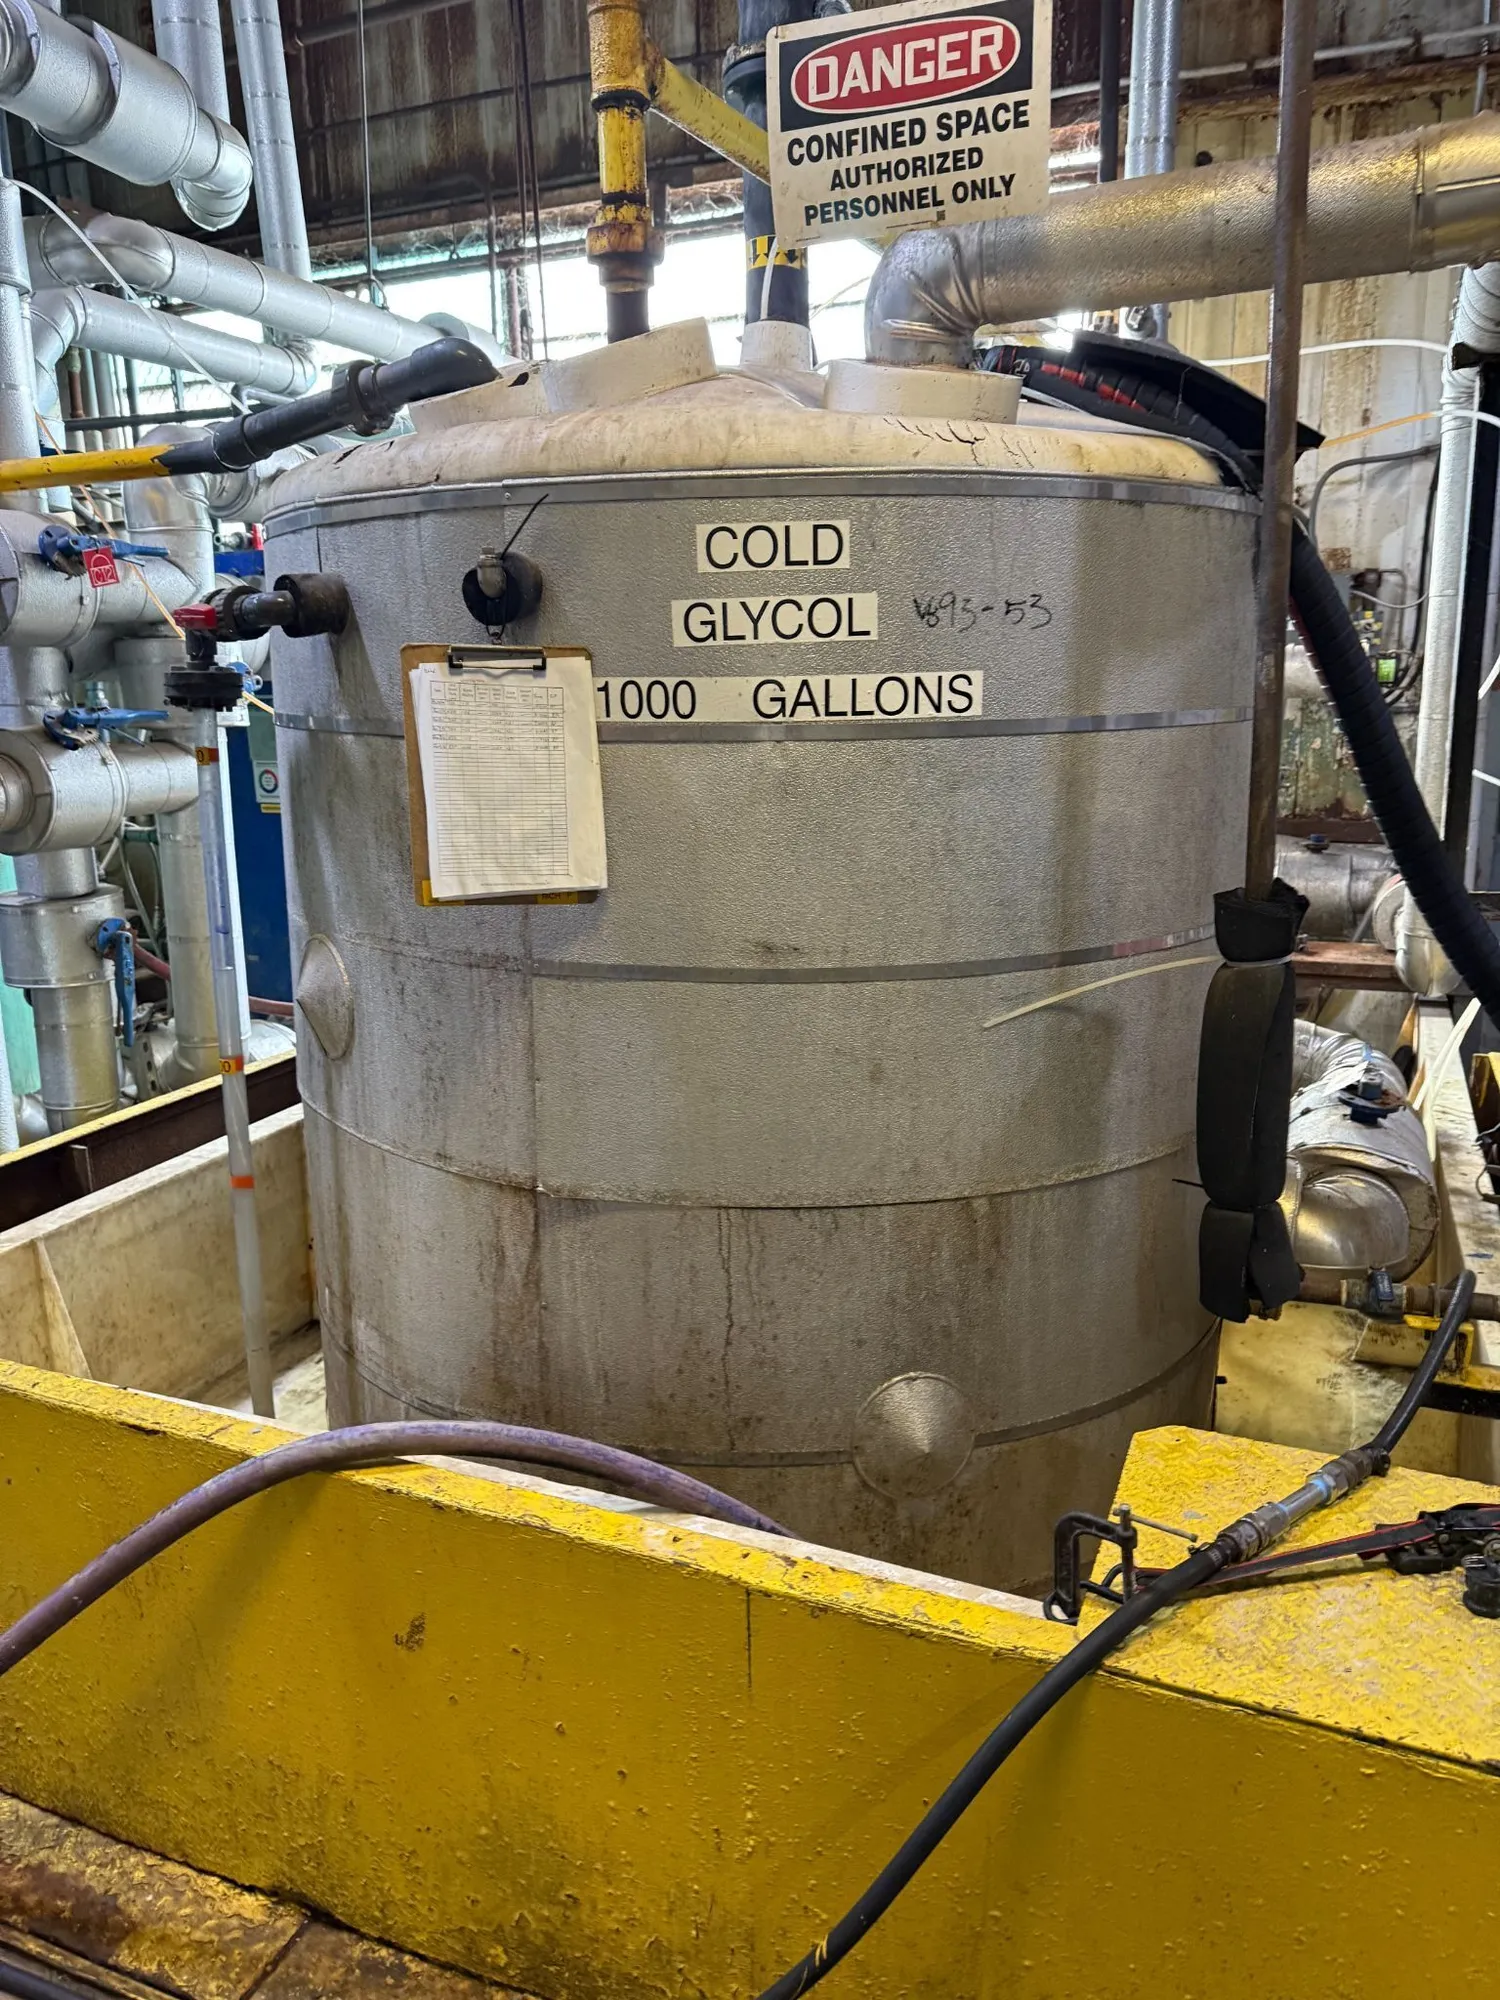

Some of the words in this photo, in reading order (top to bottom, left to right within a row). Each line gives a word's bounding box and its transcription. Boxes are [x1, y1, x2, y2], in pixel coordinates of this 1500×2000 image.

[807, 25, 1004, 105] DANGER
[786, 116, 927, 167] CONFINED
[935, 98, 1030, 142] SPACE
[830, 146, 984, 192] AUTHORIZED
[804, 185, 945, 227] PERSONNEL
[951, 173, 1016, 205] ONLY
[705, 523, 844, 570] COLD
[683, 597, 871, 643] GLYCOL
[596, 679, 697, 720] 1000
[752, 674, 973, 720] GALLONS
